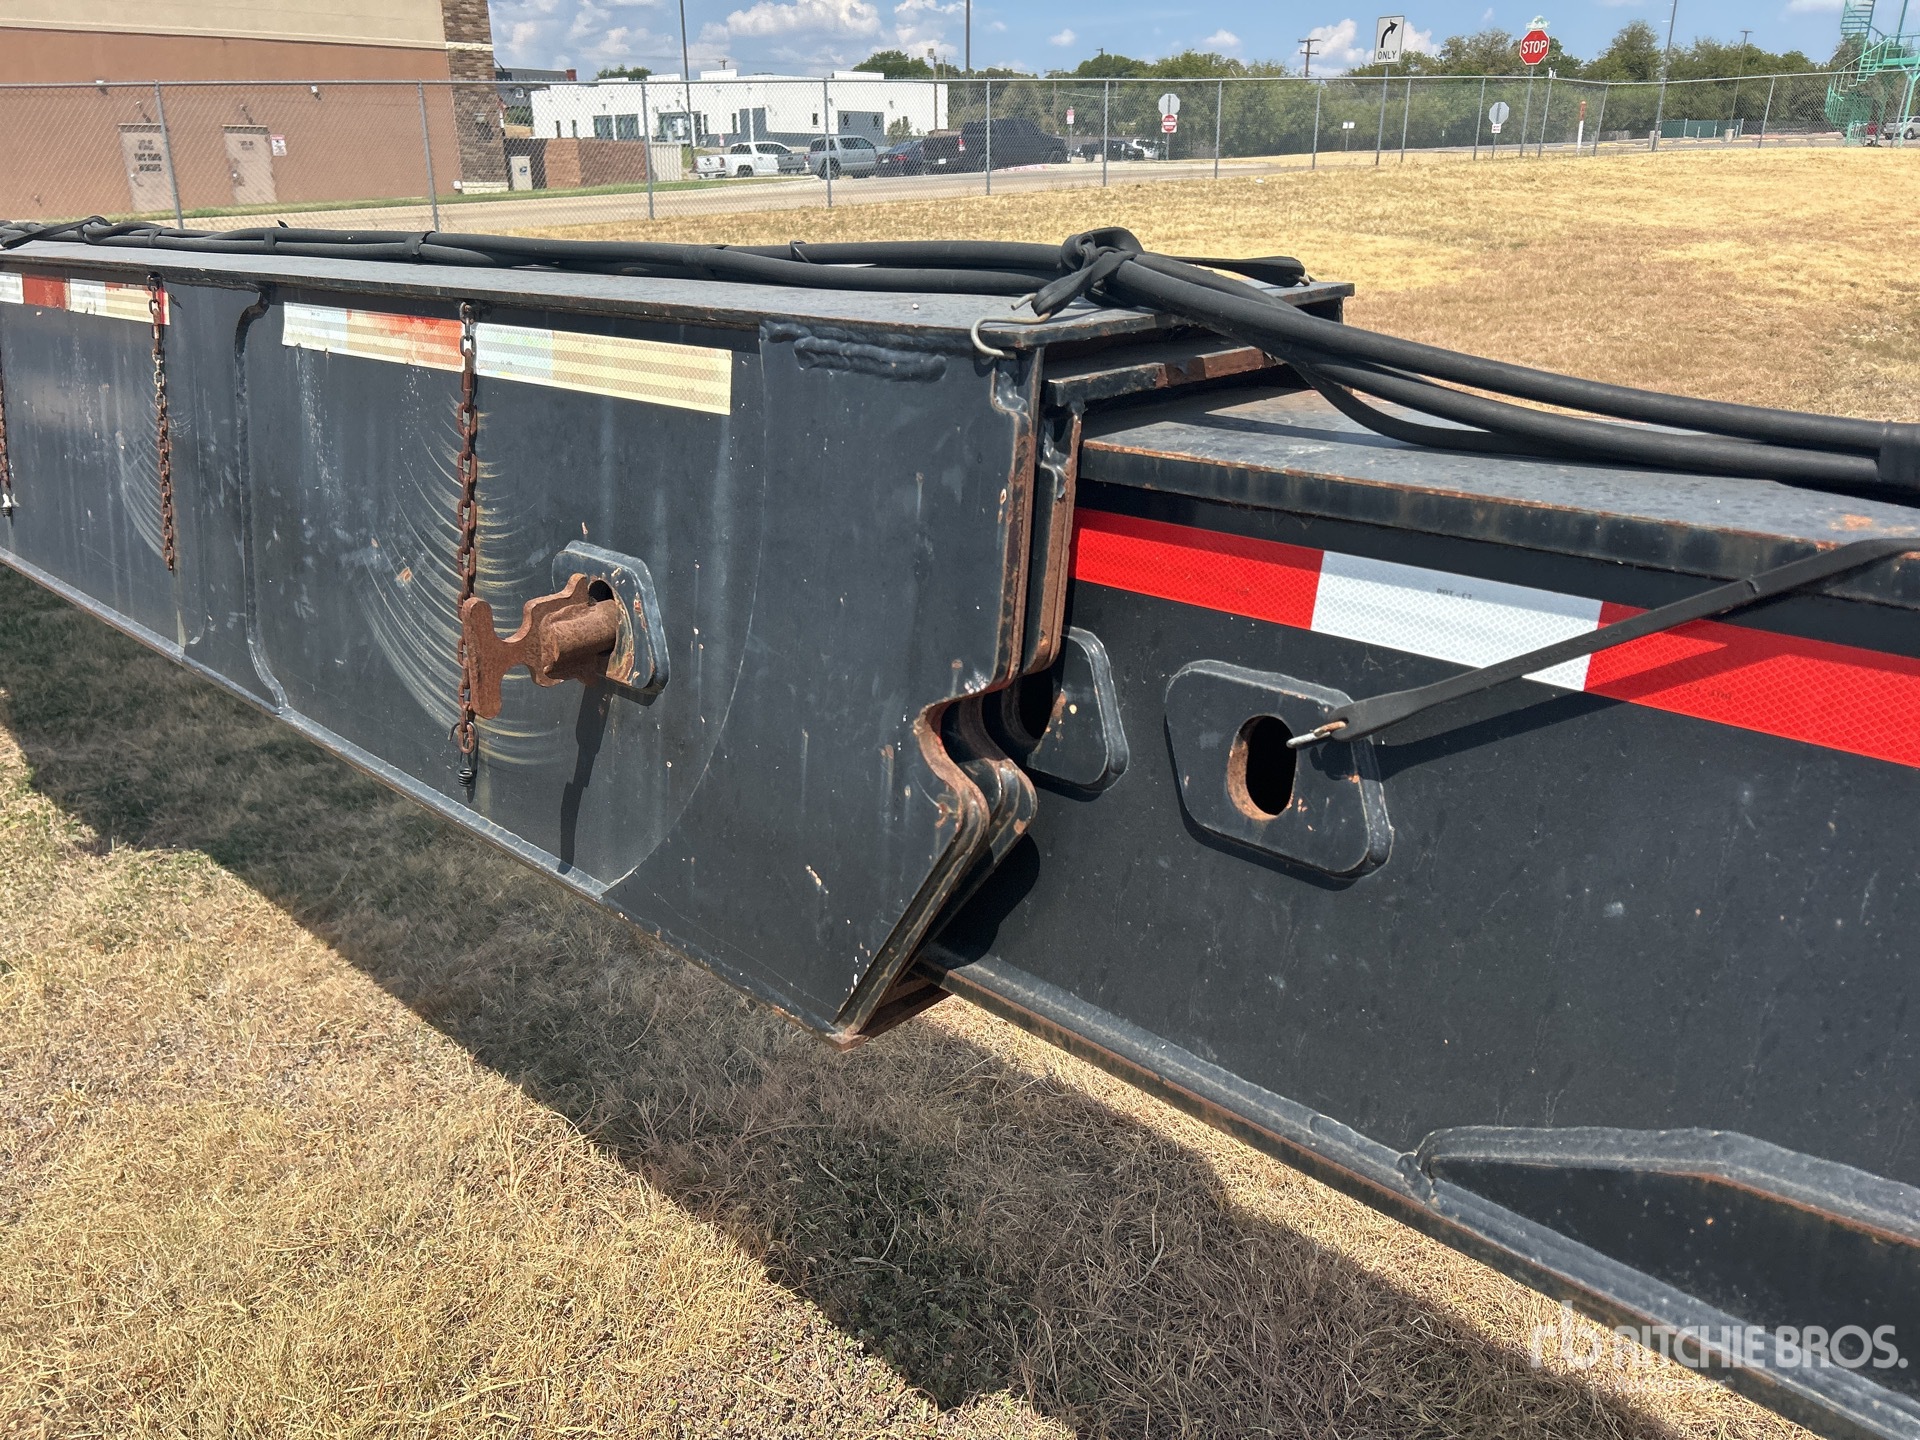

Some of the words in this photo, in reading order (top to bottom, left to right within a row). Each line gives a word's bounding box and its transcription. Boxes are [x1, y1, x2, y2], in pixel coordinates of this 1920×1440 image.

[1522, 40, 1547, 54] STOP
[1377, 50, 1397, 60] ONLY
[1437, 588, 1454, 596] DOT
